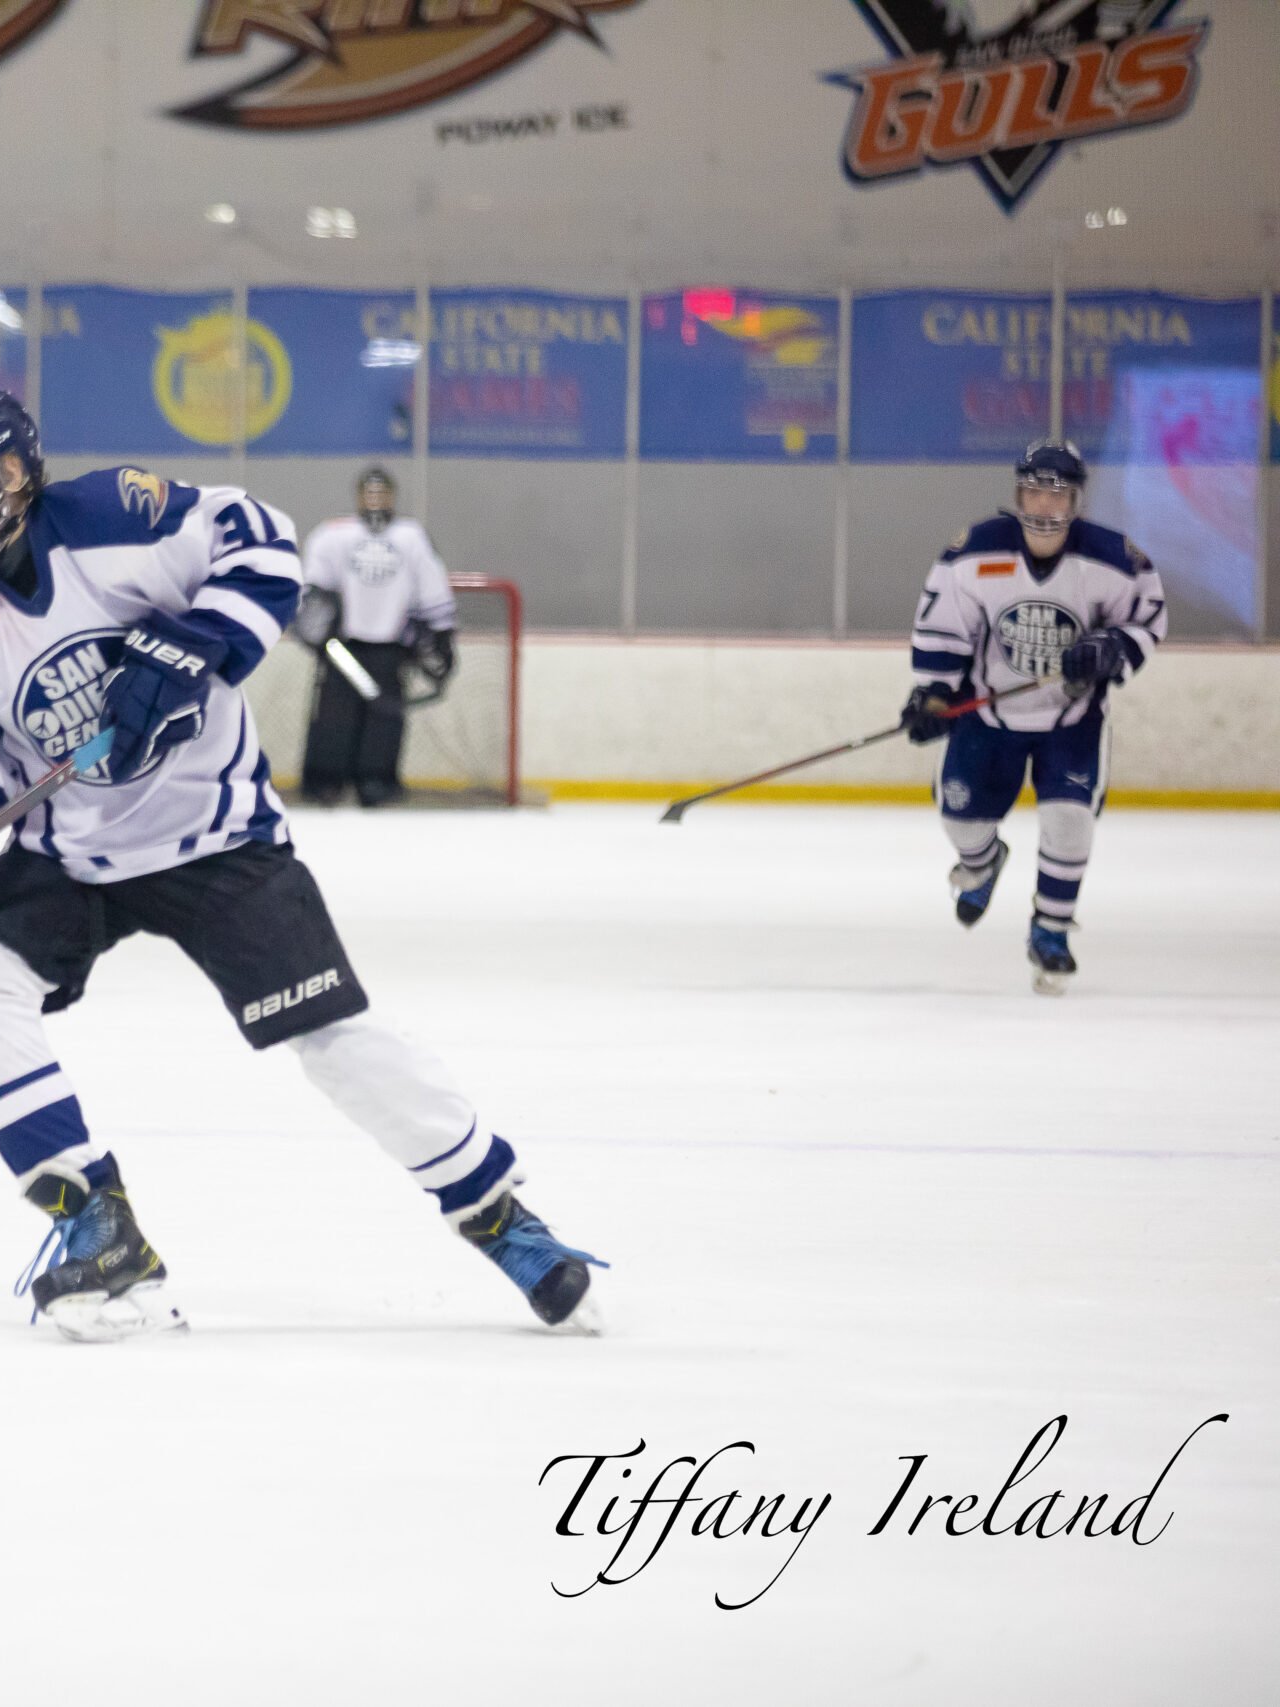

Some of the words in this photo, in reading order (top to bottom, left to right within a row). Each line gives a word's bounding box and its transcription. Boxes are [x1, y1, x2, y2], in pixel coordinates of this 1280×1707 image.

[844, 22, 1206, 182] GULLS
[436, 112, 558, 146] POWAY
[1017, 606, 1057, 628] SAN
[1127, 592, 1164, 628] 17
[36, 641, 108, 700] SAN
[124, 629, 206, 677] AUER
[51, 678, 107, 733] DIE
[43, 717, 101, 758] CEN
[243, 968, 341, 1026] BAUER
